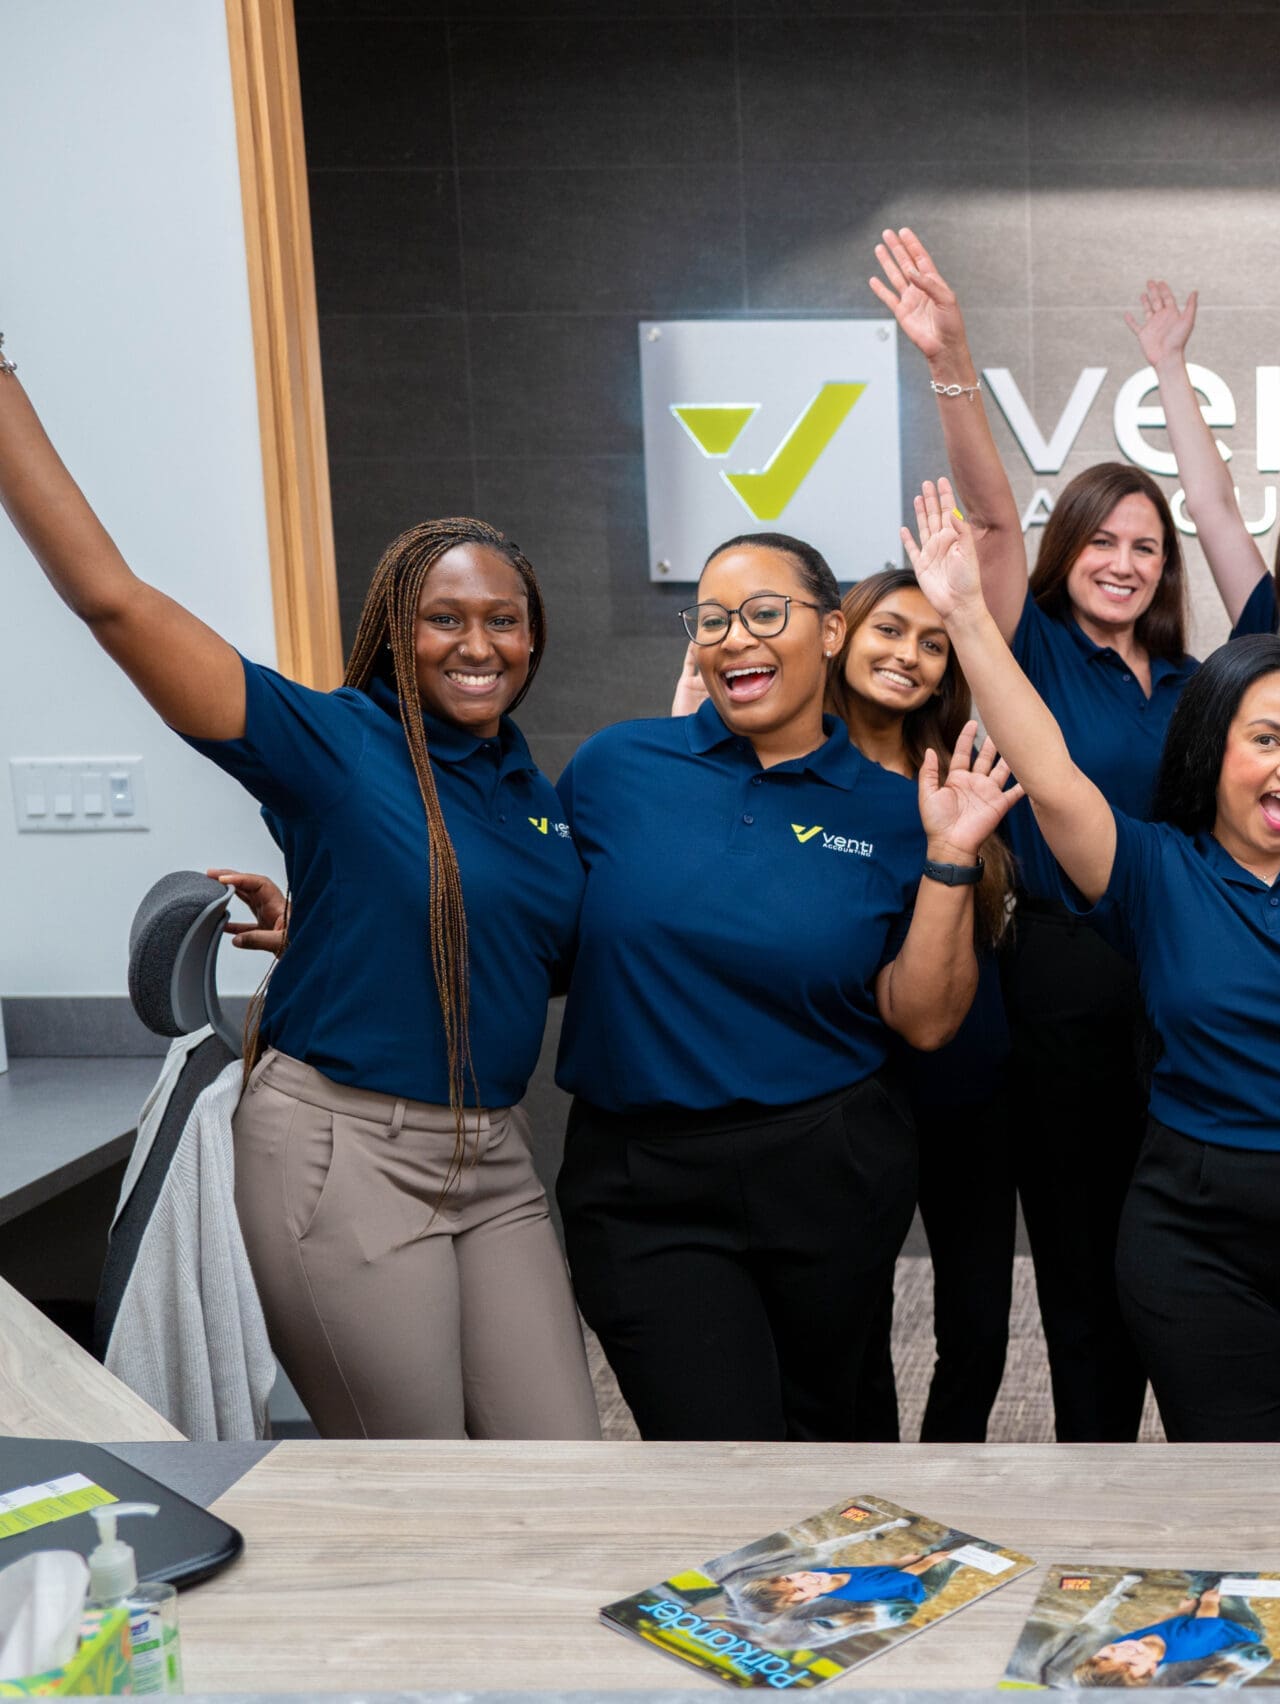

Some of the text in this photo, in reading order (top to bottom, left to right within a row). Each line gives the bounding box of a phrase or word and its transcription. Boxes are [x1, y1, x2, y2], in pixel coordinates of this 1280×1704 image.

[822, 832, 874, 855] venti
[822, 843, 871, 857] ACCOUNTING
[638, 1599, 809, 1689] Parklander
